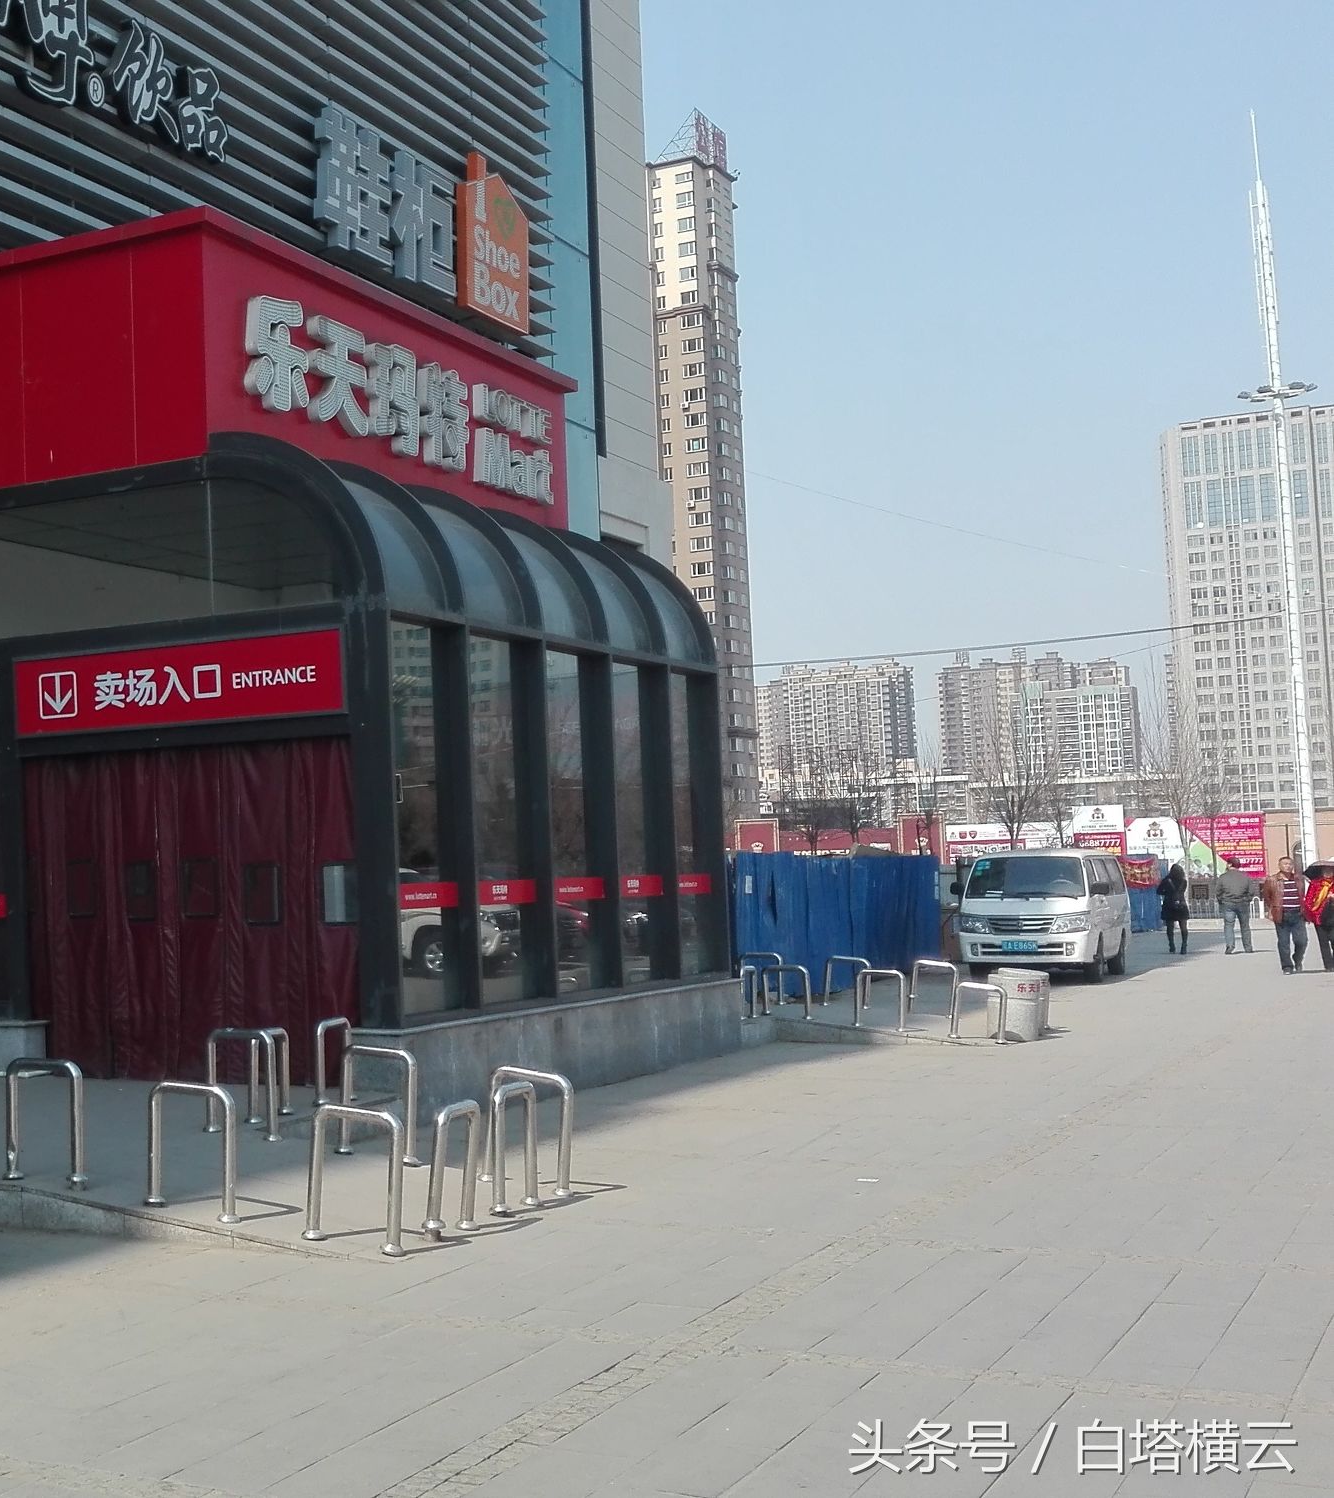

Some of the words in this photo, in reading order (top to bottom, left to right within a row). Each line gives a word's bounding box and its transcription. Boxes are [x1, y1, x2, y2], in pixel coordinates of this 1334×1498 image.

[314, 101, 458, 298] 鞋柜
[473, 222, 521, 281] Shoe
[473, 260, 520, 322] Box
[243, 295, 470, 472] 乐天玛特
[472, 382, 553, 445] LOTTE
[472, 426, 554, 505] Mart
[93, 663, 222, 711] 卖场入口
[232, 665, 317, 689] ENTRANCE
